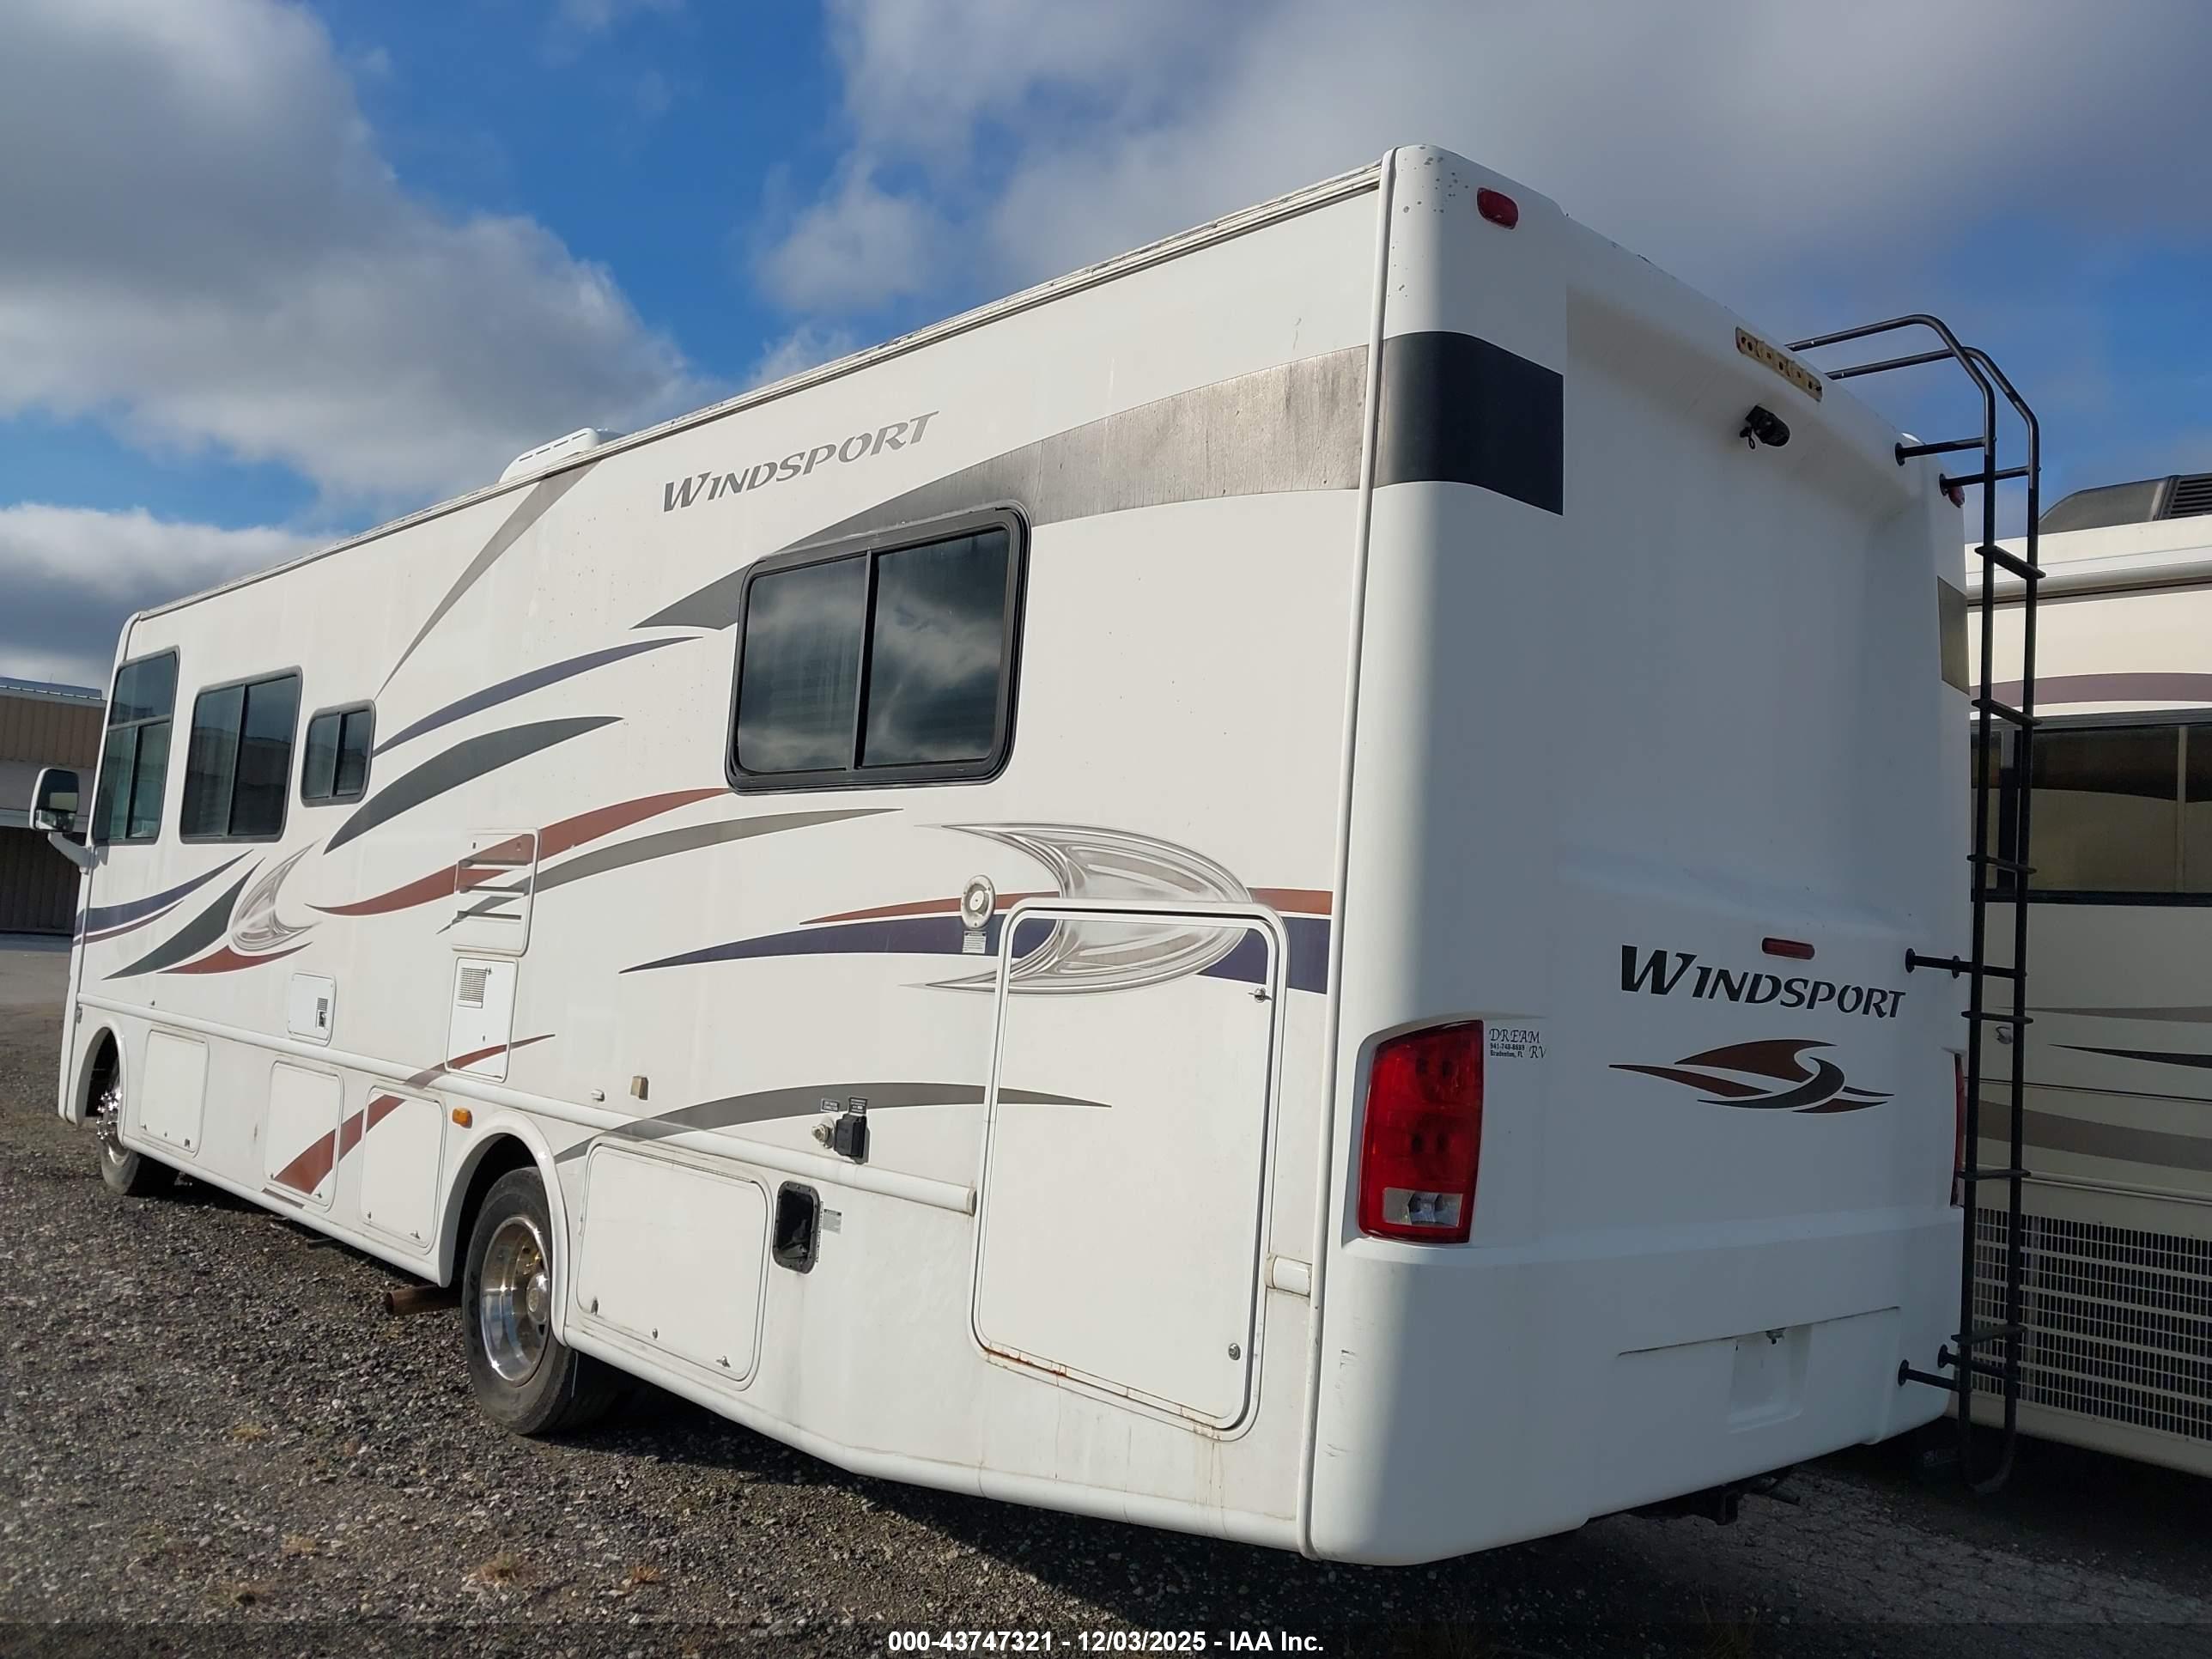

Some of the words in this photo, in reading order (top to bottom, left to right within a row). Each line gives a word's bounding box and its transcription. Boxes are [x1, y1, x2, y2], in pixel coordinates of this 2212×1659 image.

[664, 411, 939, 512] WINDSPORT
[1621, 945, 1906, 1018] WINDSPORT
[1489, 1028, 1540, 1043] DREAM
[1528, 1044, 1547, 1059] RV
